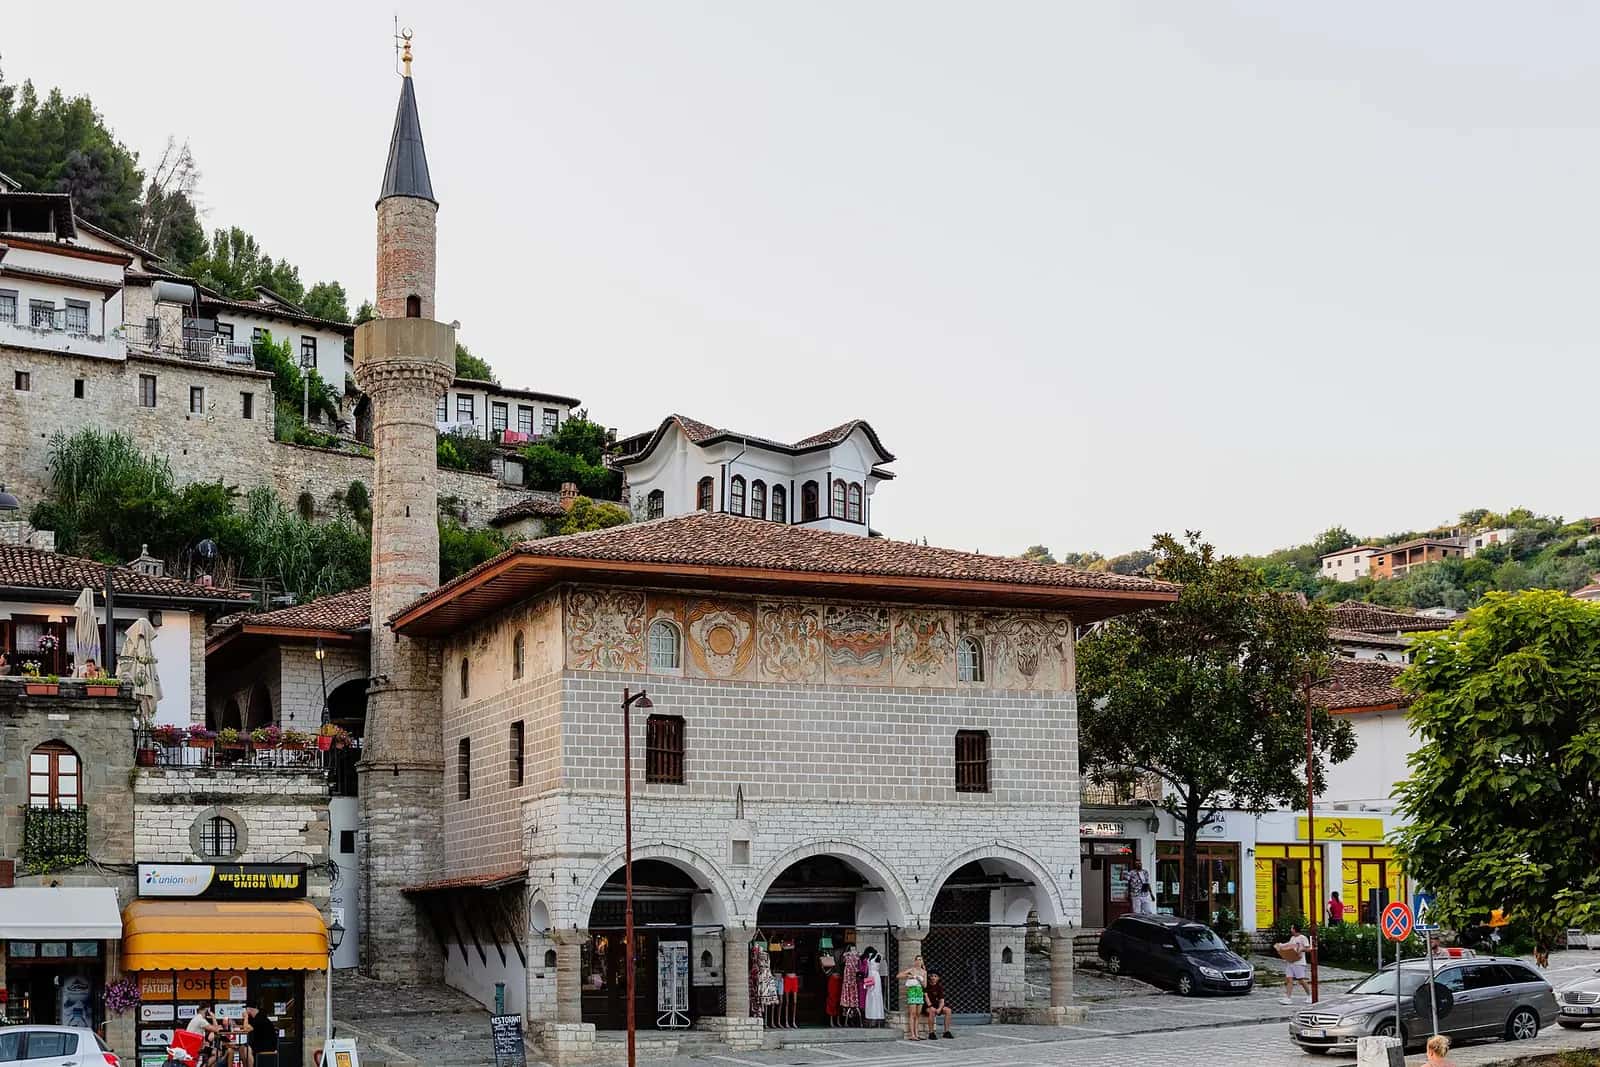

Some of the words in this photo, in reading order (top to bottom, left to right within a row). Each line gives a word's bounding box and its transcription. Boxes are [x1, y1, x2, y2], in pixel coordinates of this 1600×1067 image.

[1096, 823, 1125, 832] ARLIN
[218, 873, 267, 882] WESTERN
[233, 881, 267, 889] UNION
